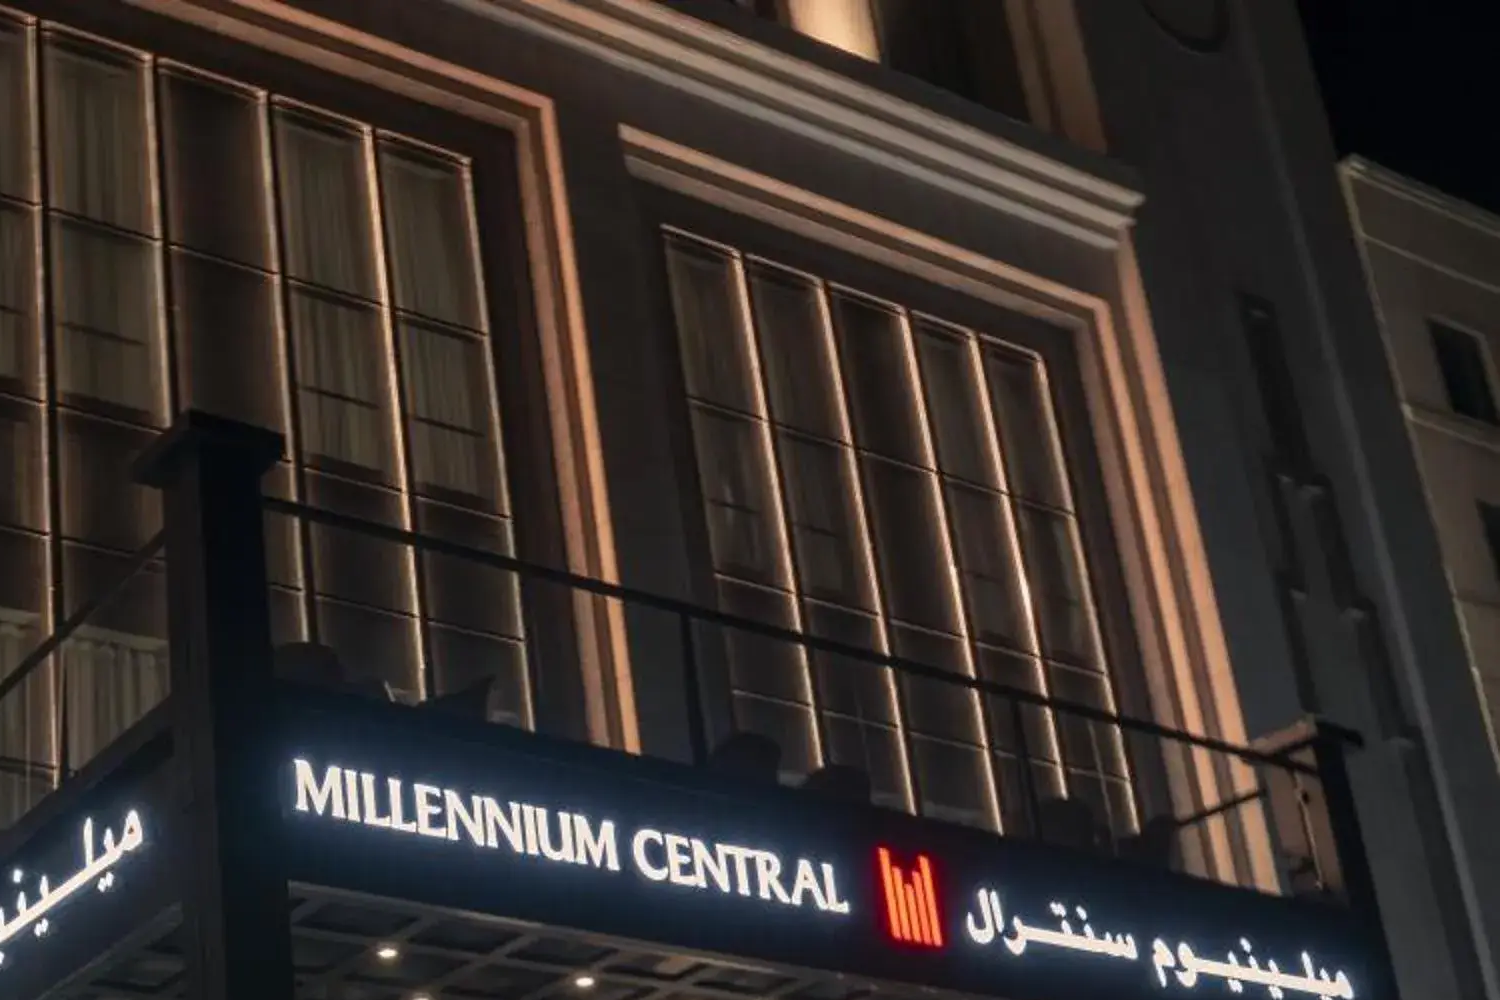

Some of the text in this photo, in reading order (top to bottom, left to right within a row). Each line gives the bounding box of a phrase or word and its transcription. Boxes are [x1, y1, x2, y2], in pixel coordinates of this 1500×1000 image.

[293, 757, 850, 914] MILLENNIUM CENTRAL
[966, 887, 1139, 960] سنترال
